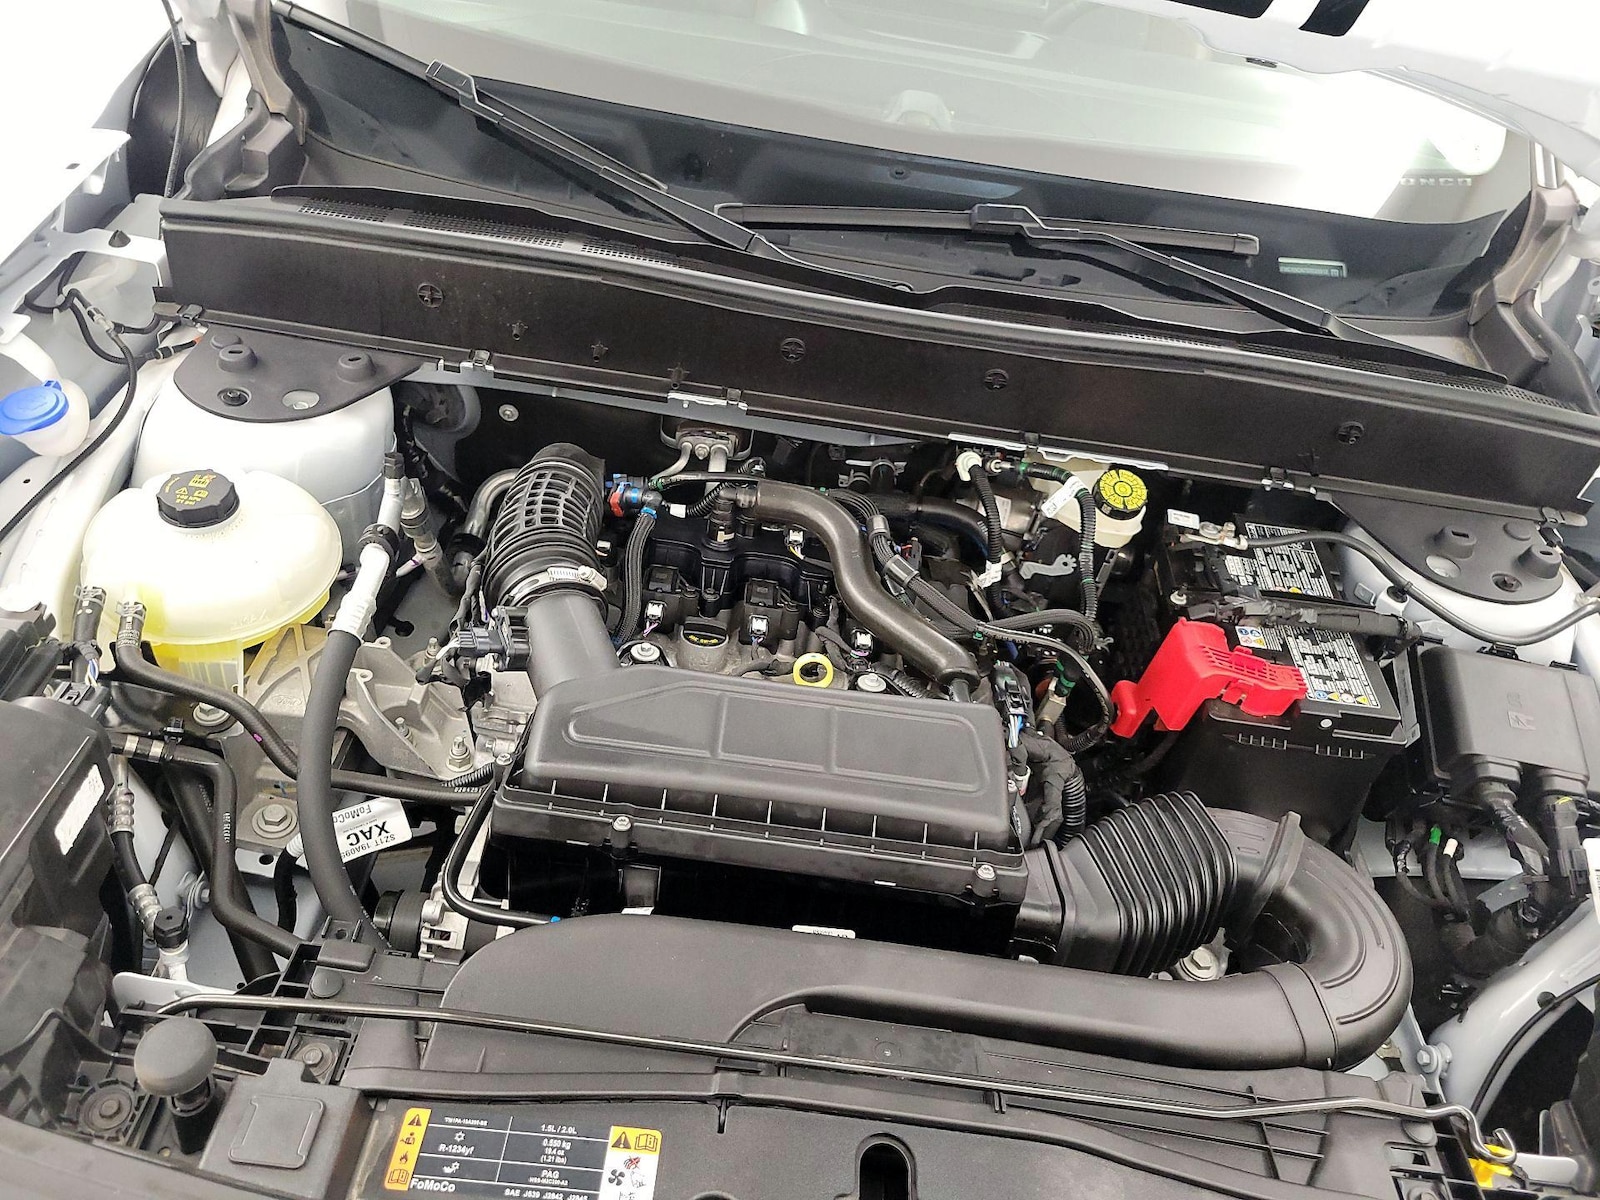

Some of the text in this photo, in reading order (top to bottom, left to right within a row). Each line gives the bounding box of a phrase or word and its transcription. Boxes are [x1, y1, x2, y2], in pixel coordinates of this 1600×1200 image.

[1399, 177, 1472, 187] ONCO
[346, 820, 391, 846] XAC
[541, 1123, 557, 1133] 1.5L
[561, 1125, 577, 1135] 2.0L
[438, 1143, 475, 1156] R-1234yf
[561, 1140, 572, 1150] kg
[541, 1169, 560, 1179] PAG
[410, 1177, 456, 1193] FoMoCo
[504, 1187, 521, 1197] SAE
